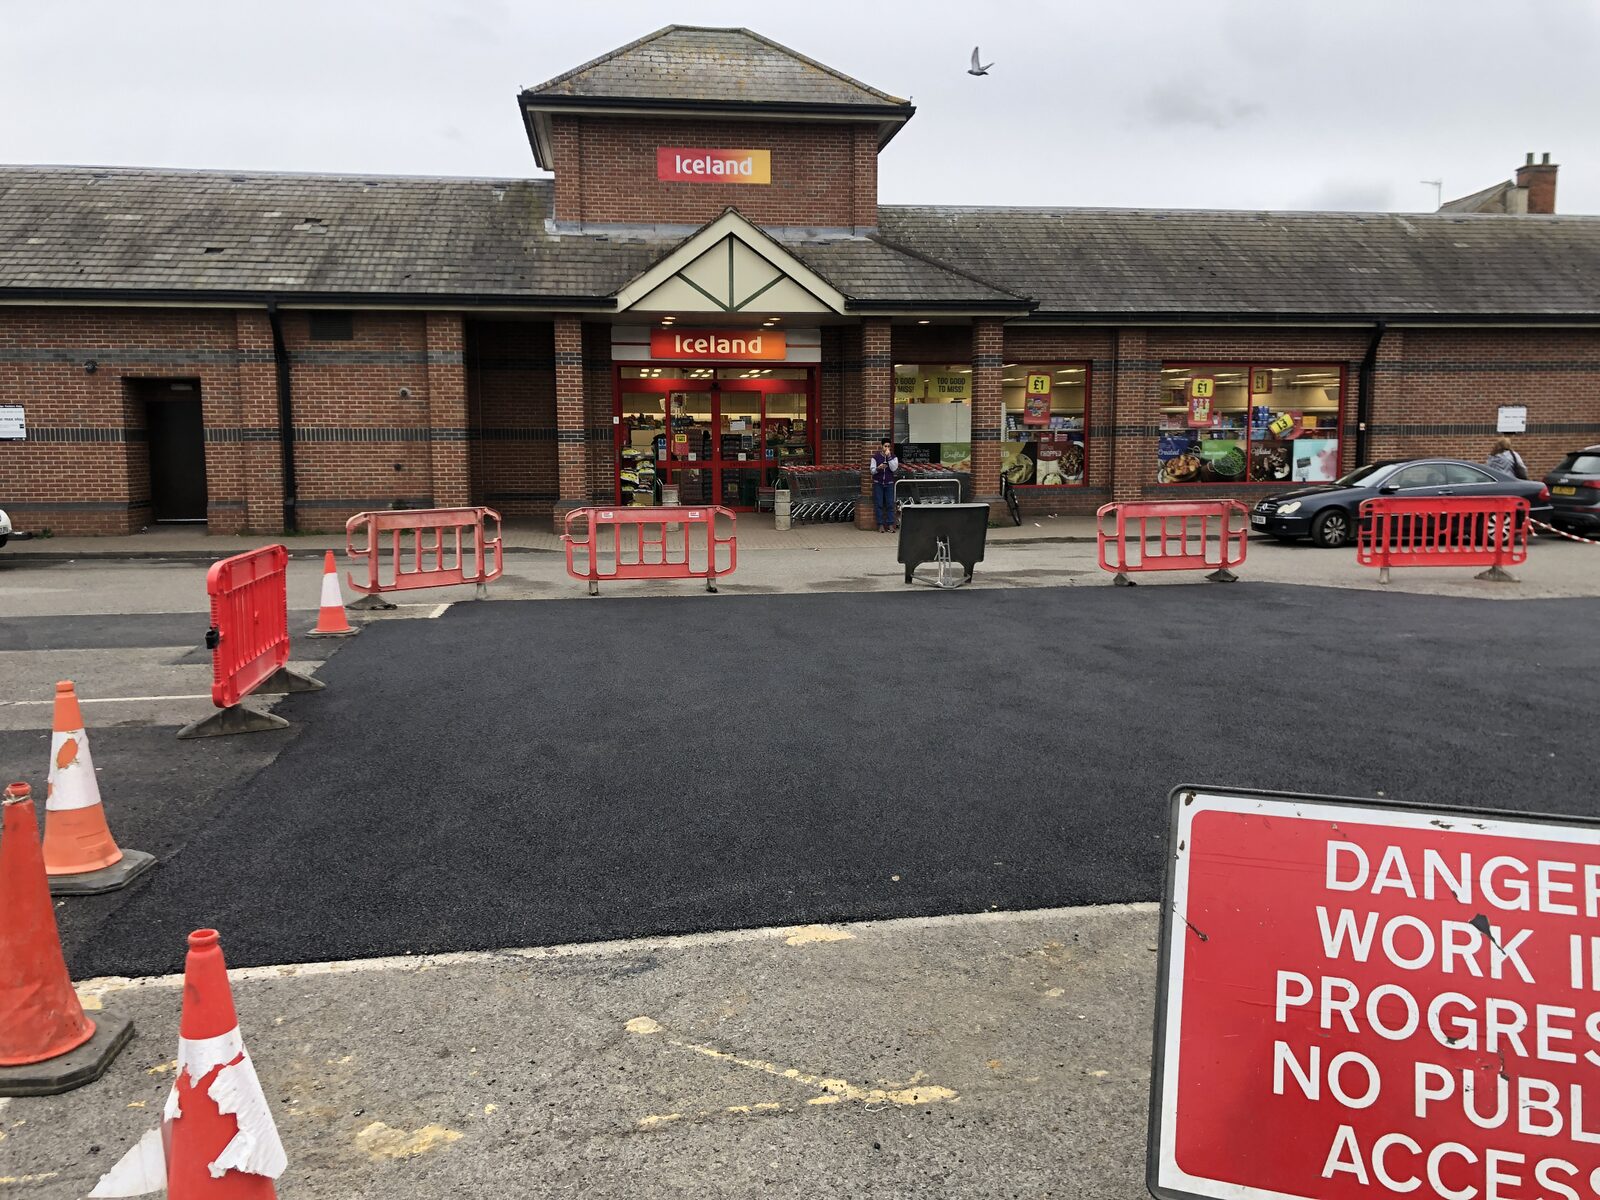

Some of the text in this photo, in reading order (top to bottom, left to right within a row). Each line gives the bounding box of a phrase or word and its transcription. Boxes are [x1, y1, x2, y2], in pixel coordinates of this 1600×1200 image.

[675, 155, 752, 176] Iceland
[675, 335, 762, 354] Iceland
[1034, 379, 1044, 390] £1
[1198, 382, 1207, 394] £1
[1316, 905, 1600, 992] WORK I
[1273, 1040, 1381, 1110] NO
[1321, 1124, 1600, 1200] ACCES
